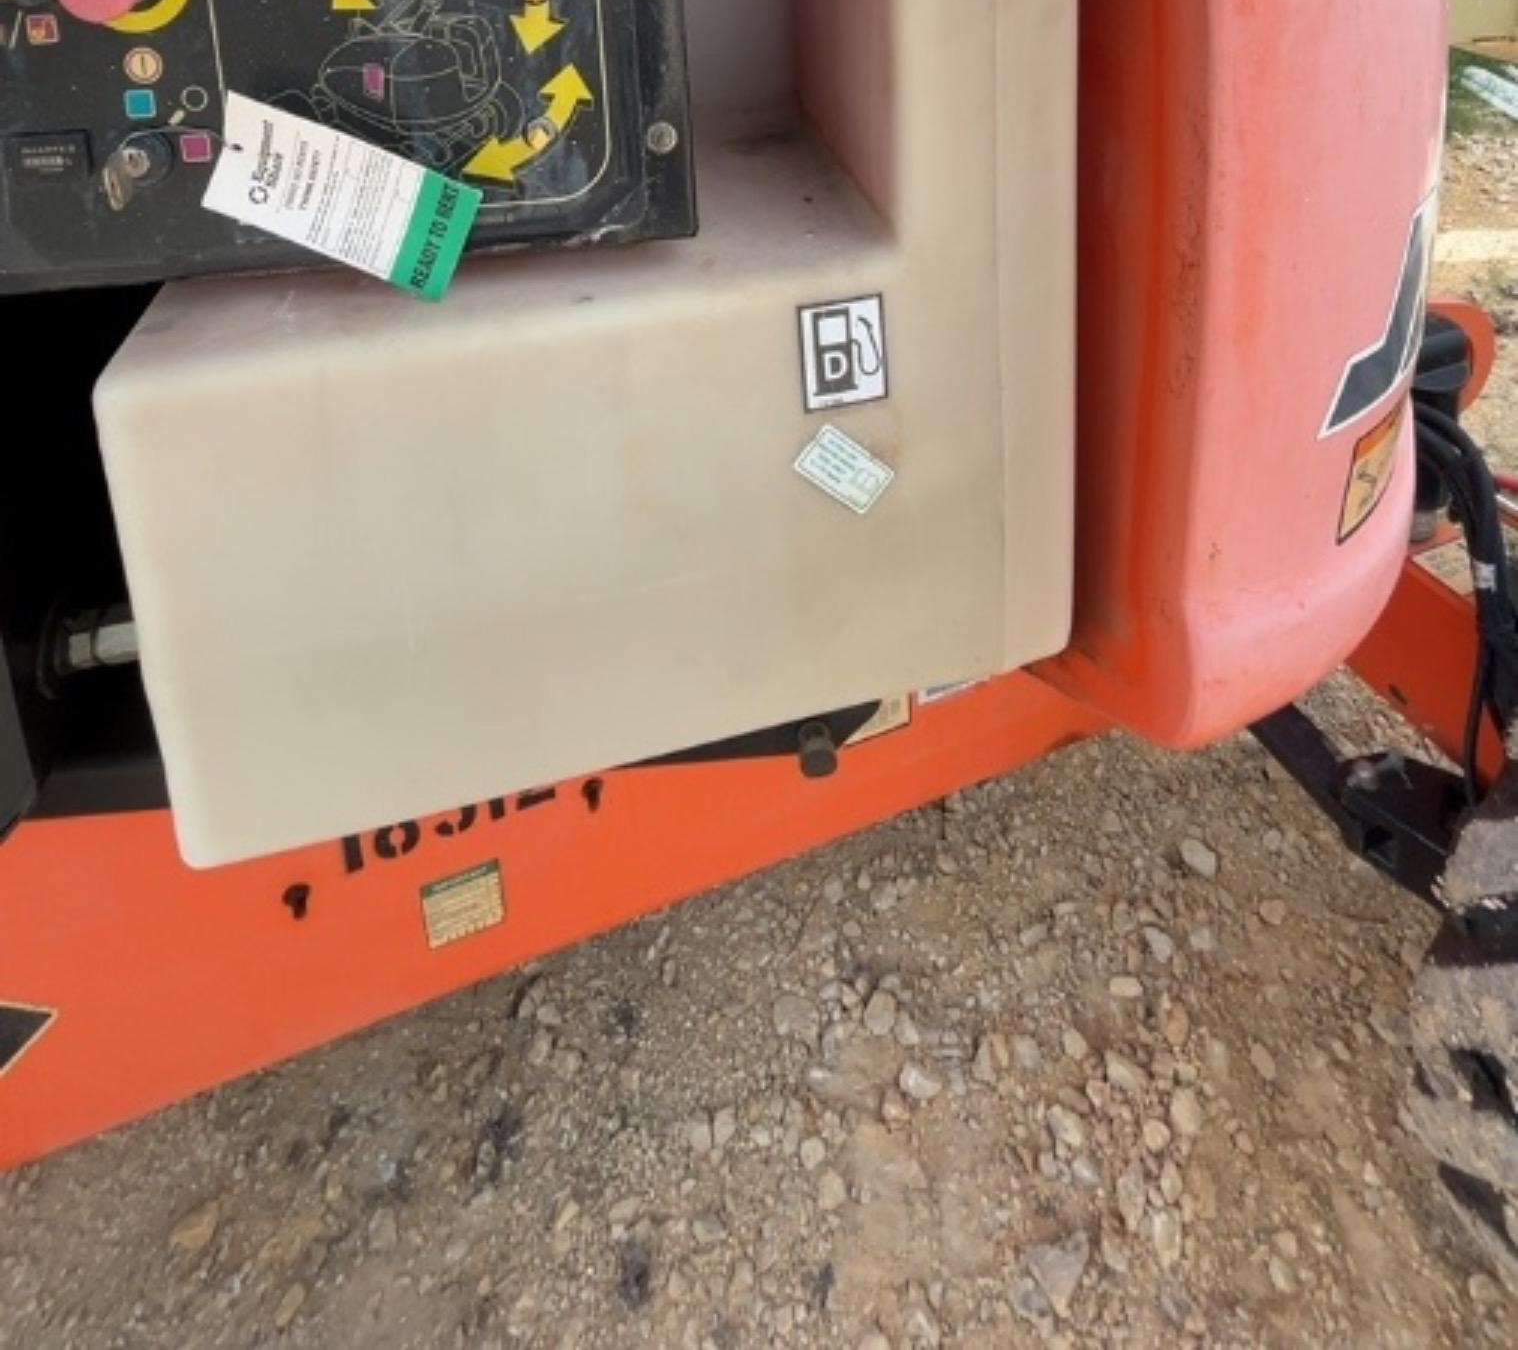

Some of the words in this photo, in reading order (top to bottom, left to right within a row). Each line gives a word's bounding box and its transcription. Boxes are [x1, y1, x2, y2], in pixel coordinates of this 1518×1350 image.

[410, 239, 442, 289] READY
[428, 218, 448, 239] TO
[823, 351, 849, 382] D
